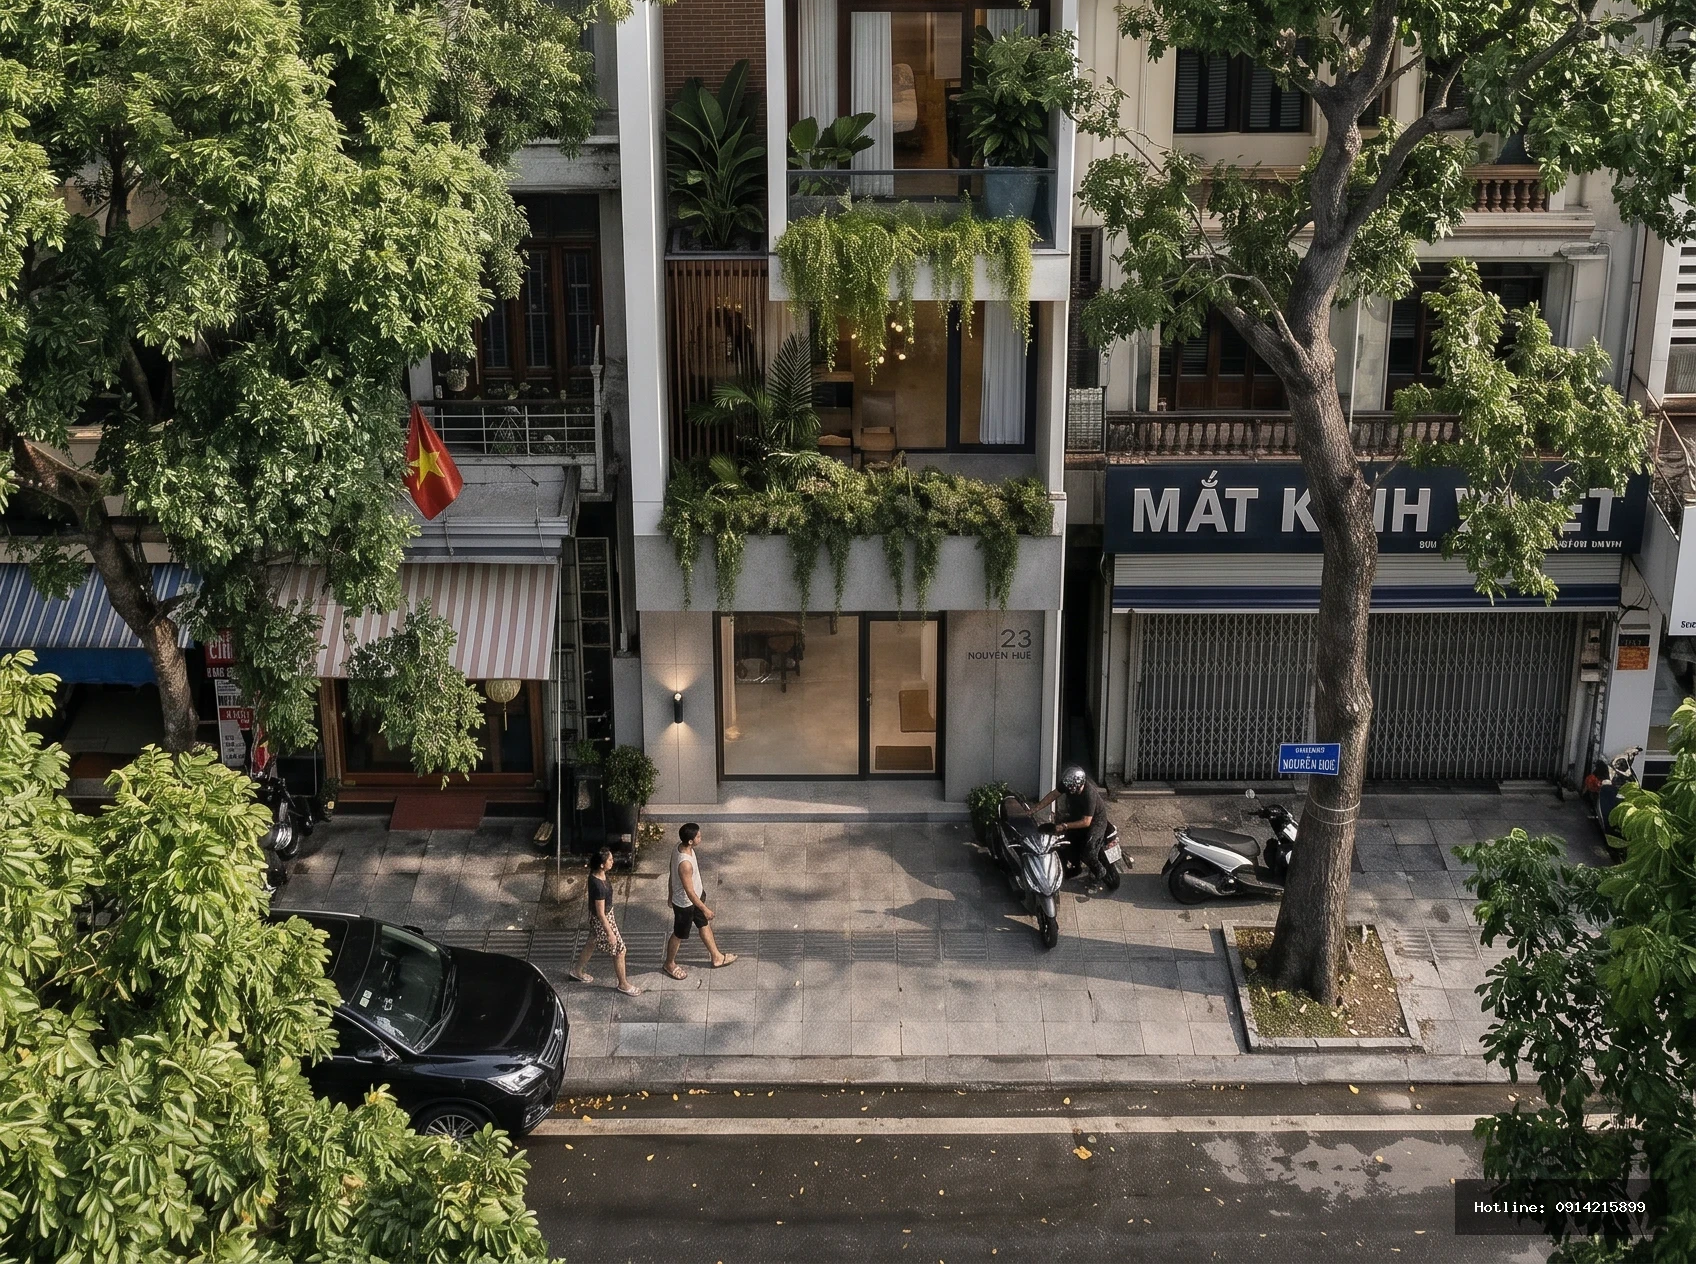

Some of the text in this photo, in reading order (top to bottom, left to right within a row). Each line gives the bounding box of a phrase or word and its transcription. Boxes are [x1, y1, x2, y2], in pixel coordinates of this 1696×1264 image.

[1133, 469, 1259, 533] MẮT
[1281, 487, 1431, 533] KH
[1000, 628, 1032, 648] 23
